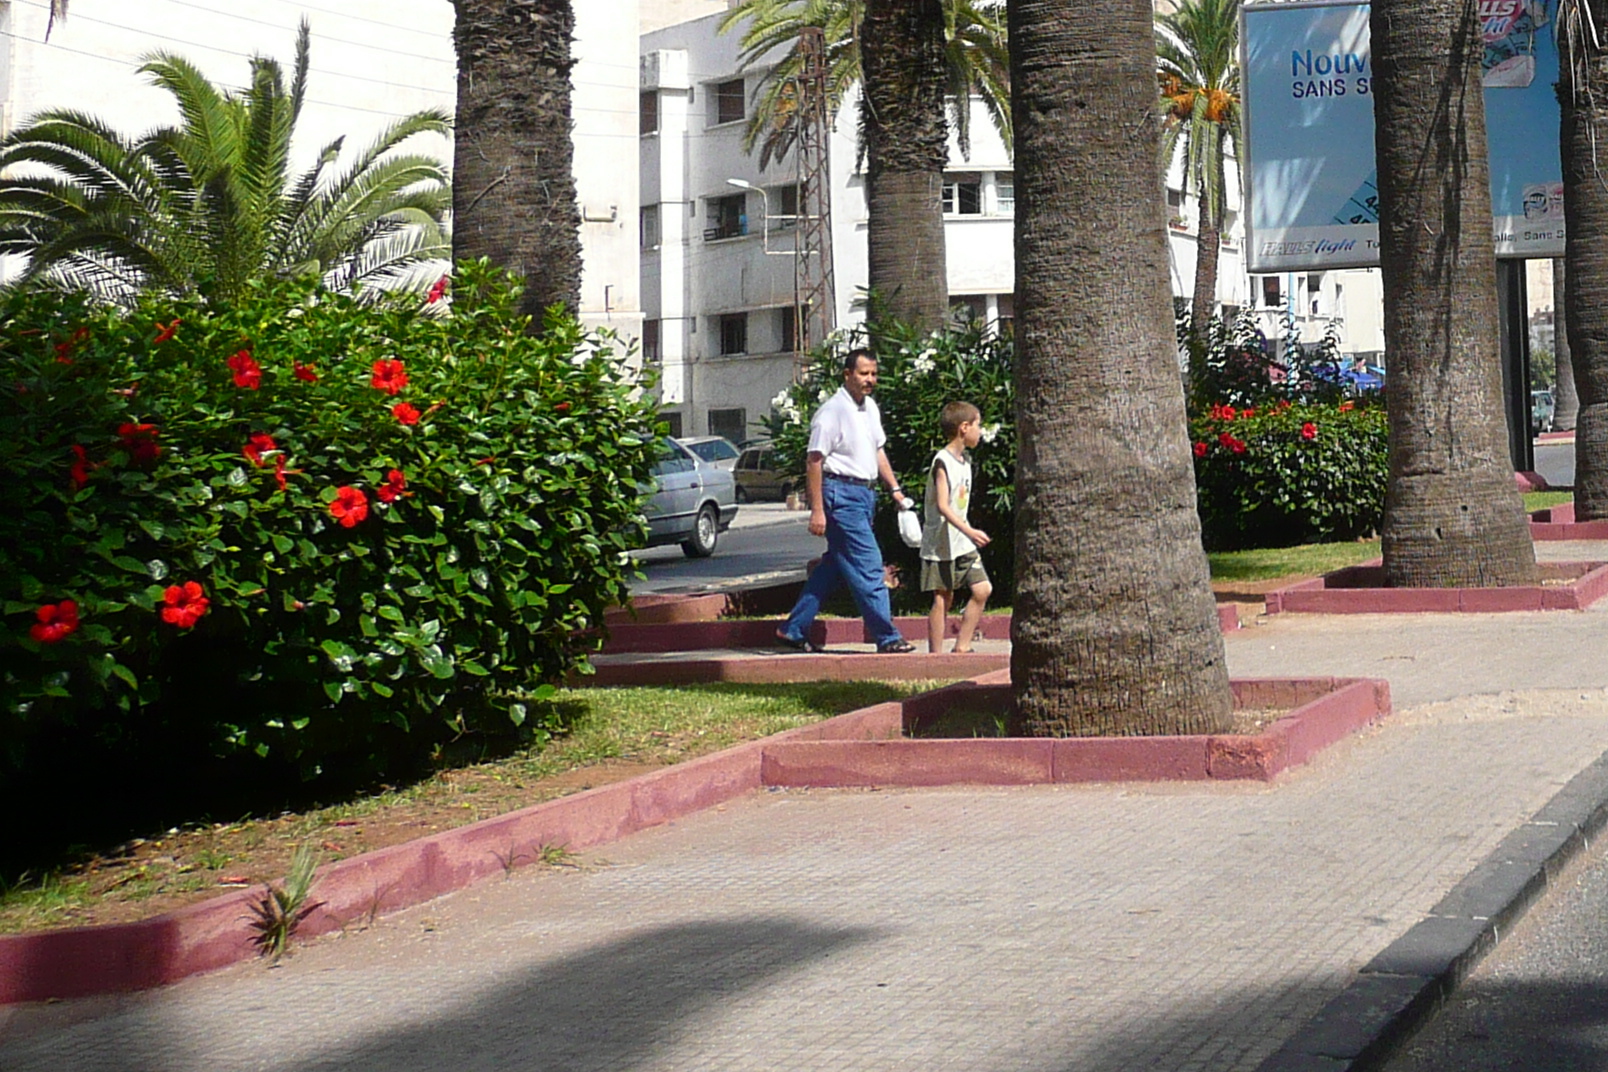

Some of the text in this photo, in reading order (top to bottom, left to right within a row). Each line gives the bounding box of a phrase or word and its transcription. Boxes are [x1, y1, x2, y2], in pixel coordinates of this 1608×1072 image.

[1291, 49, 1367, 77] Nouv
[1292, 78, 1346, 99] SANS
[1259, 240, 1315, 257] HALLS
[1315, 238, 1358, 255] light
